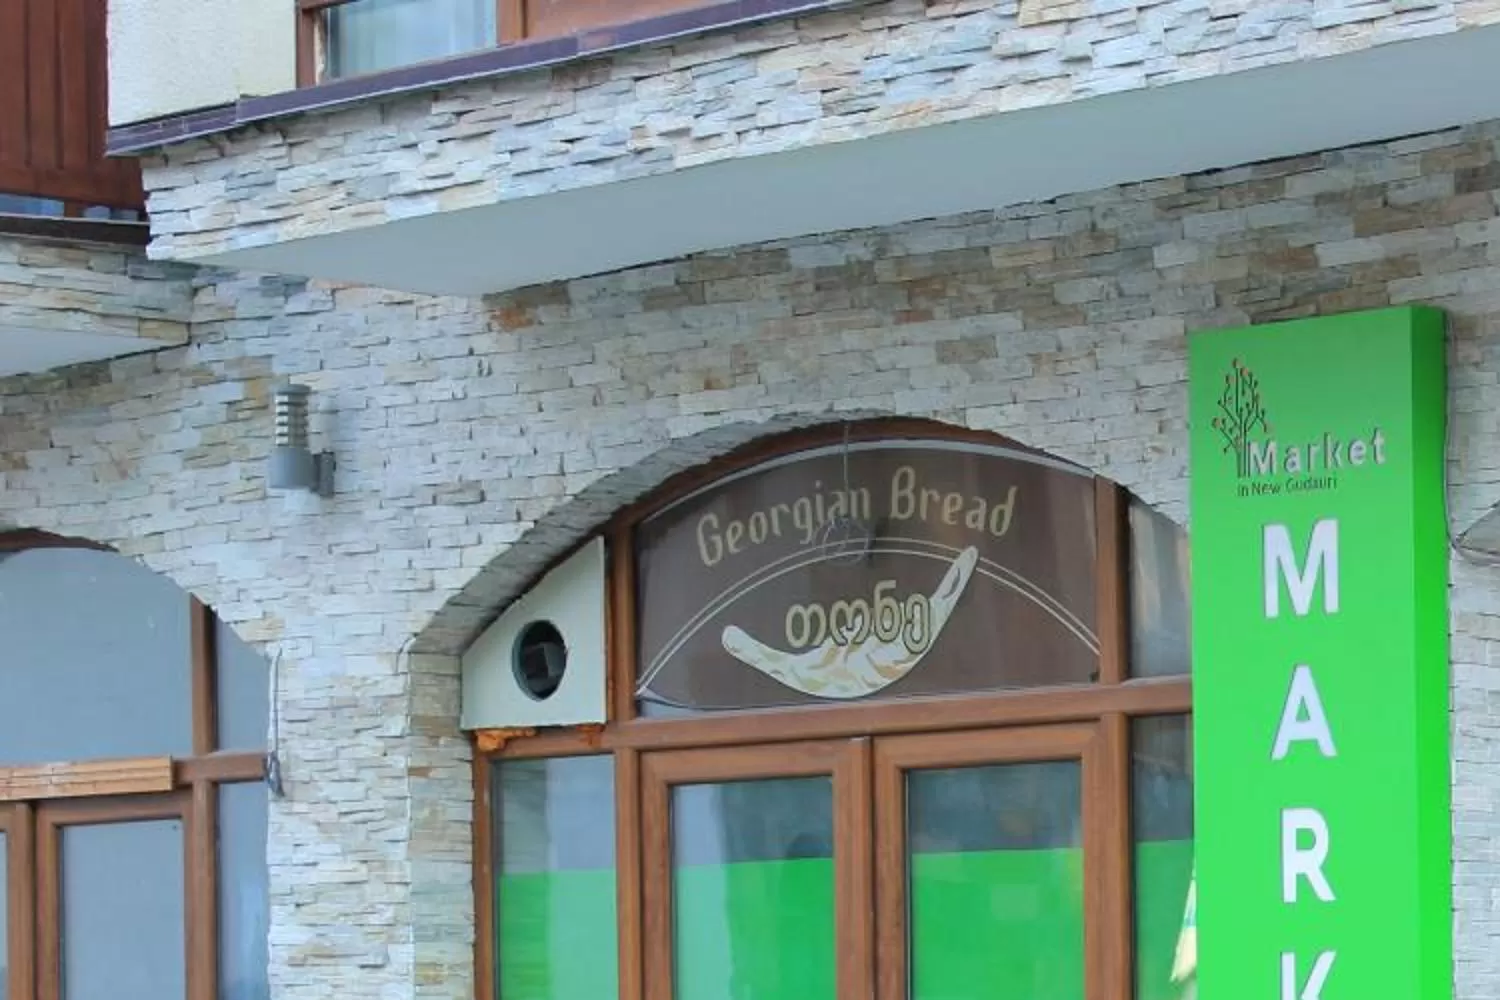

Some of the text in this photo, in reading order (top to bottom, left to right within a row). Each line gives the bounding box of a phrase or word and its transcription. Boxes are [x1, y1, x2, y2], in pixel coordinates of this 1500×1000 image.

[1247, 427, 1386, 476] Market
[1251, 481, 1281, 496] New
[1284, 473, 1338, 494] Gudauri
[696, 465, 1019, 567] Georgian Bread
[785, 579, 931, 653] თონე
